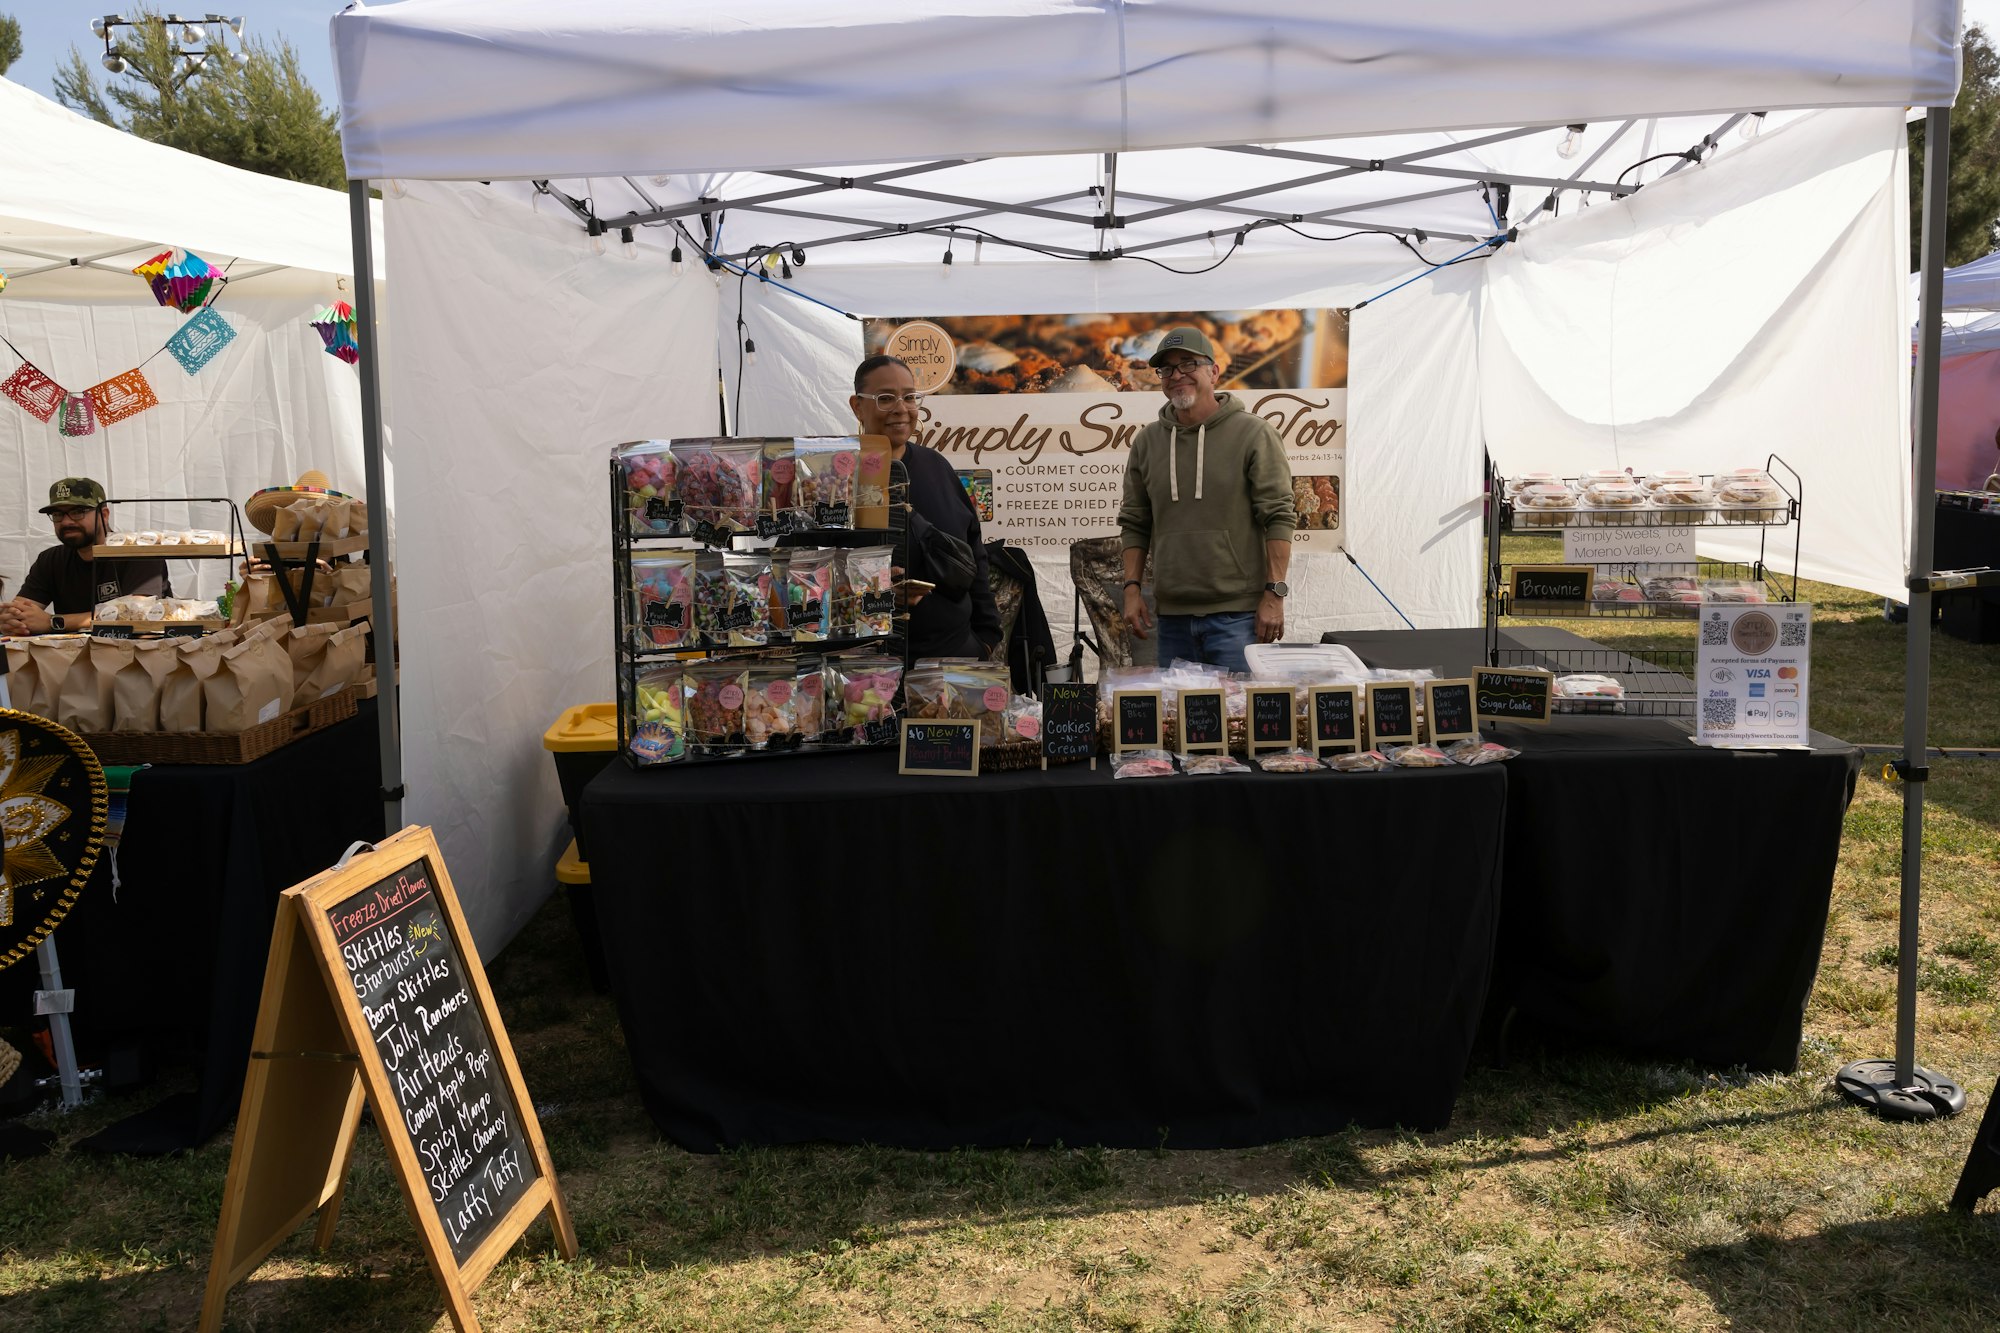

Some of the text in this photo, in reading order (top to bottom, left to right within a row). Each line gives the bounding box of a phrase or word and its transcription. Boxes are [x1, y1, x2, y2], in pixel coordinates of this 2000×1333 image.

[898, 335, 941, 354] Simply
[1252, 393, 1342, 447] Too
[1311, 453, 1343, 461] 24:13-14
[1005, 464, 1075, 476] GOURMET
[1005, 481, 1117, 493] CUSTOM SUGAR
[1006, 500, 1058, 510] FREEZE
[1064, 499, 1107, 510] DRIED
[1006, 517, 1066, 528] ARTISAN
[1571, 528, 1612, 546] Simply
[1614, 528, 1662, 541] Sweets,
[1574, 547, 1622, 559] Moreno
[1624, 545, 1663, 558] Valley,
[1521, 578, 1581, 597] Brownie
[1481, 673, 1501, 686] PYO
[1745, 668, 1771, 679] VISA
[1053, 687, 1080, 700] New
[1256, 695, 1281, 712] Party
[1479, 696, 1508, 714] Sugar
[1509, 697, 1532, 711] Cookie
[1322, 710, 1348, 720] Please
[1754, 708, 1768, 718] Pay
[1784, 709, 1796, 718] Pay
[1047, 719, 1091, 734] Cookies
[637, 737, 666, 751] NEW
[1048, 741, 1089, 755] Cream
[330, 875, 427, 937] Freeze Dried Flavors
[413, 923, 433, 941] New
[343, 925, 403, 972] Skittles
[353, 940, 416, 999] Starburst
[363, 958, 449, 1031] Berry Skittles
[376, 988, 468, 1072] Jolly Ranchers
[405, 1048, 490, 1136] Candy Apple Pops
[420, 1092, 491, 1173] Spicy Mango
[472, 1110, 508, 1154] Chamoy
[447, 1148, 524, 1244] Laffy Taffy
